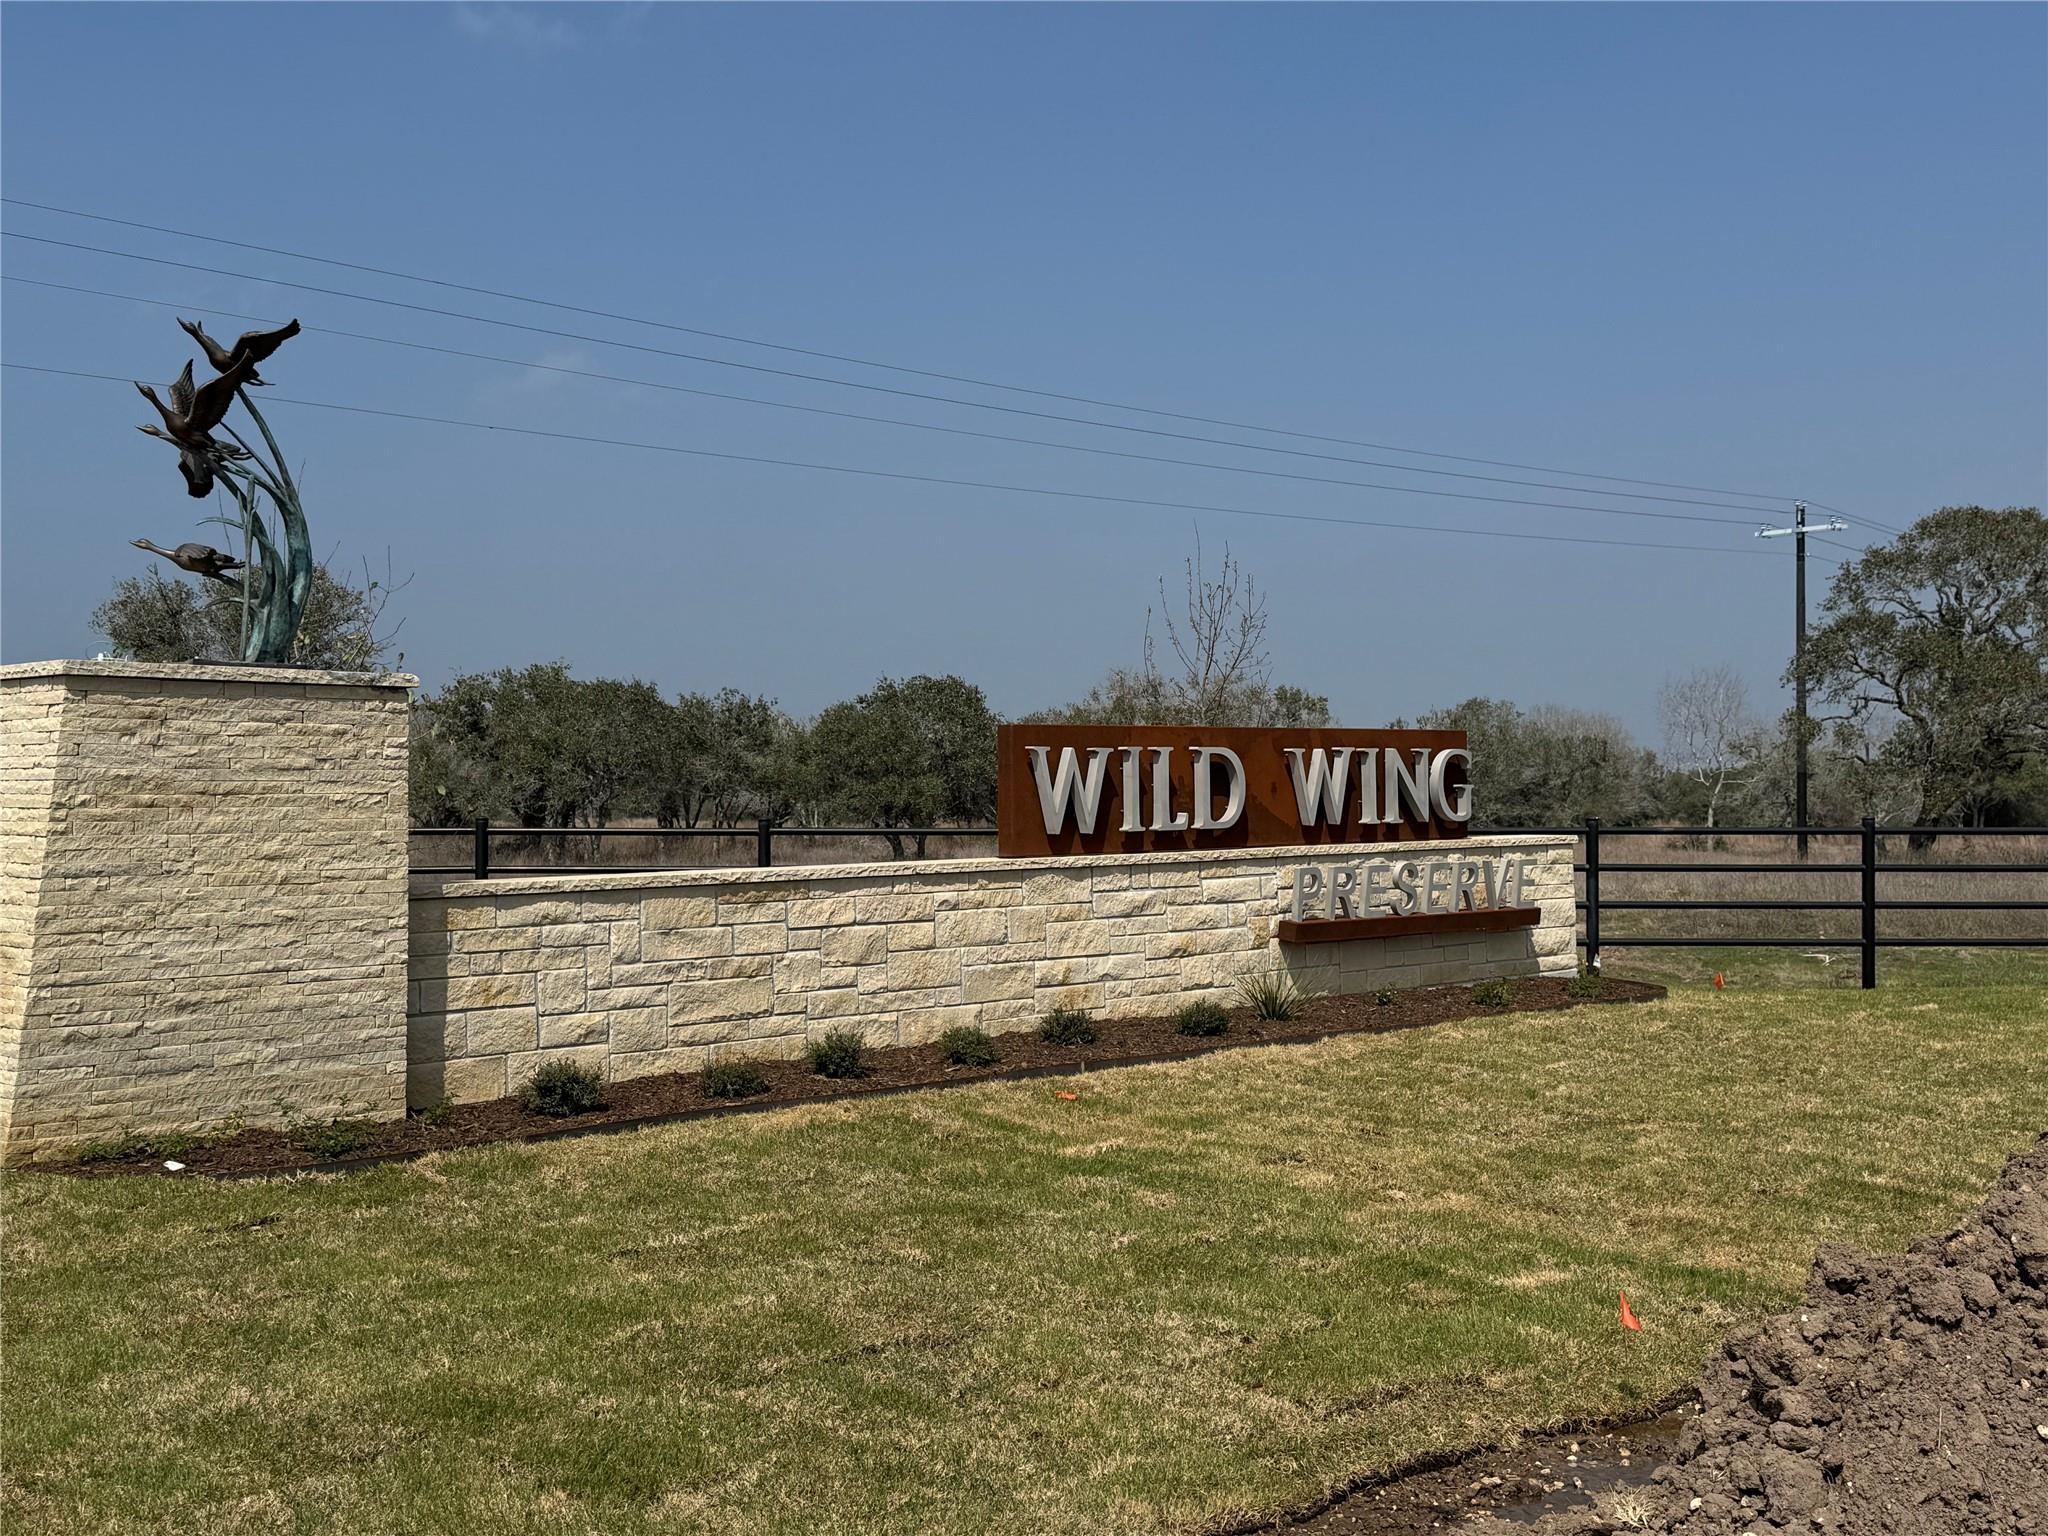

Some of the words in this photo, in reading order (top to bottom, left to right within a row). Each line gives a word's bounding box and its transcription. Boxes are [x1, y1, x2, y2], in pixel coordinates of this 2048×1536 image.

[1025, 746, 1247, 835] WILD
[1284, 747, 1474, 826] WING
[1291, 858, 1536, 922] PRESERVE
